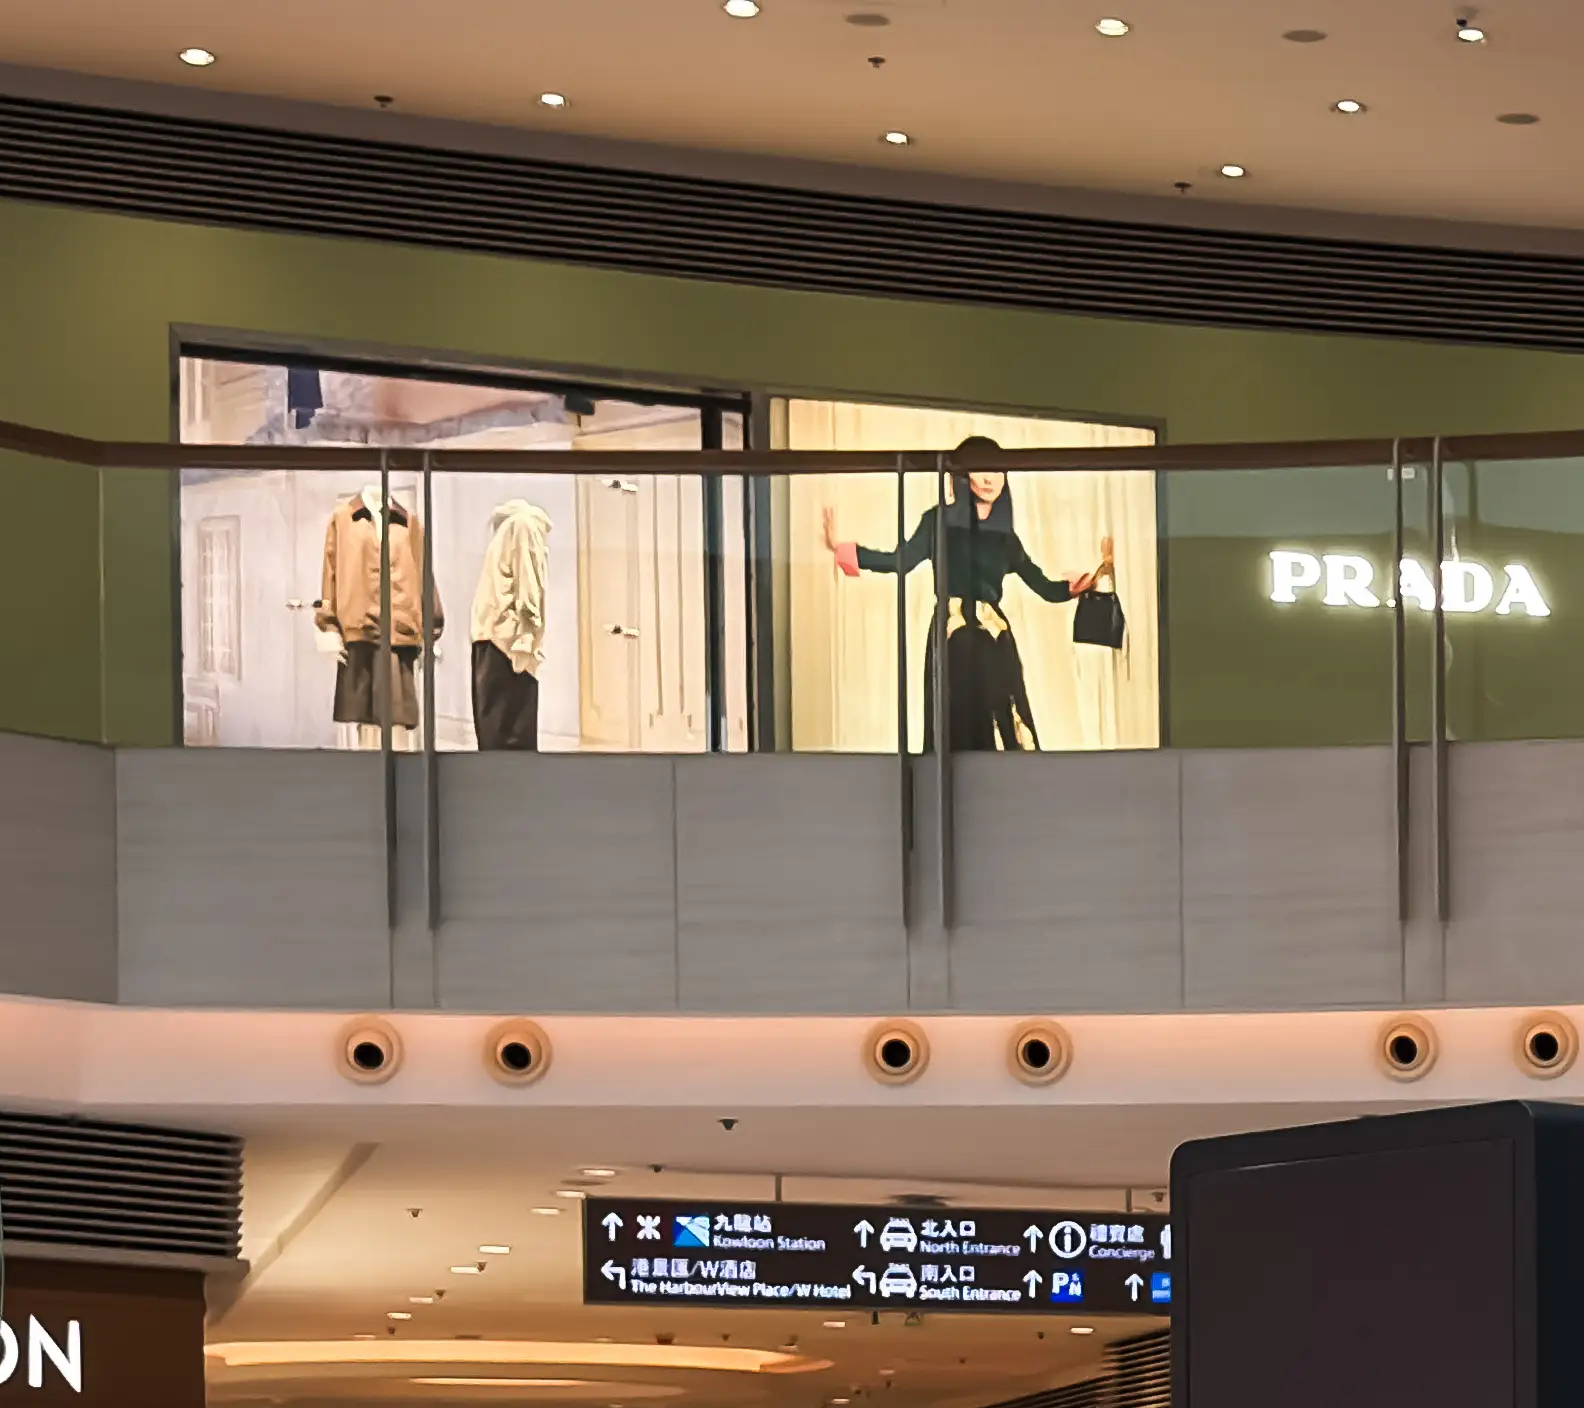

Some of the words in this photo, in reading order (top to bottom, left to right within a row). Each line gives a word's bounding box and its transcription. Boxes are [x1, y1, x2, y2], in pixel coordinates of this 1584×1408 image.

[1268, 551, 1551, 616] PRADA
[920, 1219, 976, 1238] 北入口
[713, 1235, 774, 1250] Kowloon
[777, 1236, 826, 1251] Station
[919, 1240, 961, 1255] North
[962, 1241, 1021, 1257] Entrance
[1088, 1245, 1155, 1263] Concierge
[920, 1264, 976, 1283] 南入口
[630, 1279, 657, 1295] The
[813, 1283, 852, 1300] Hotel
[918, 1285, 961, 1301] South
[962, 1286, 1022, 1302] Entrance
